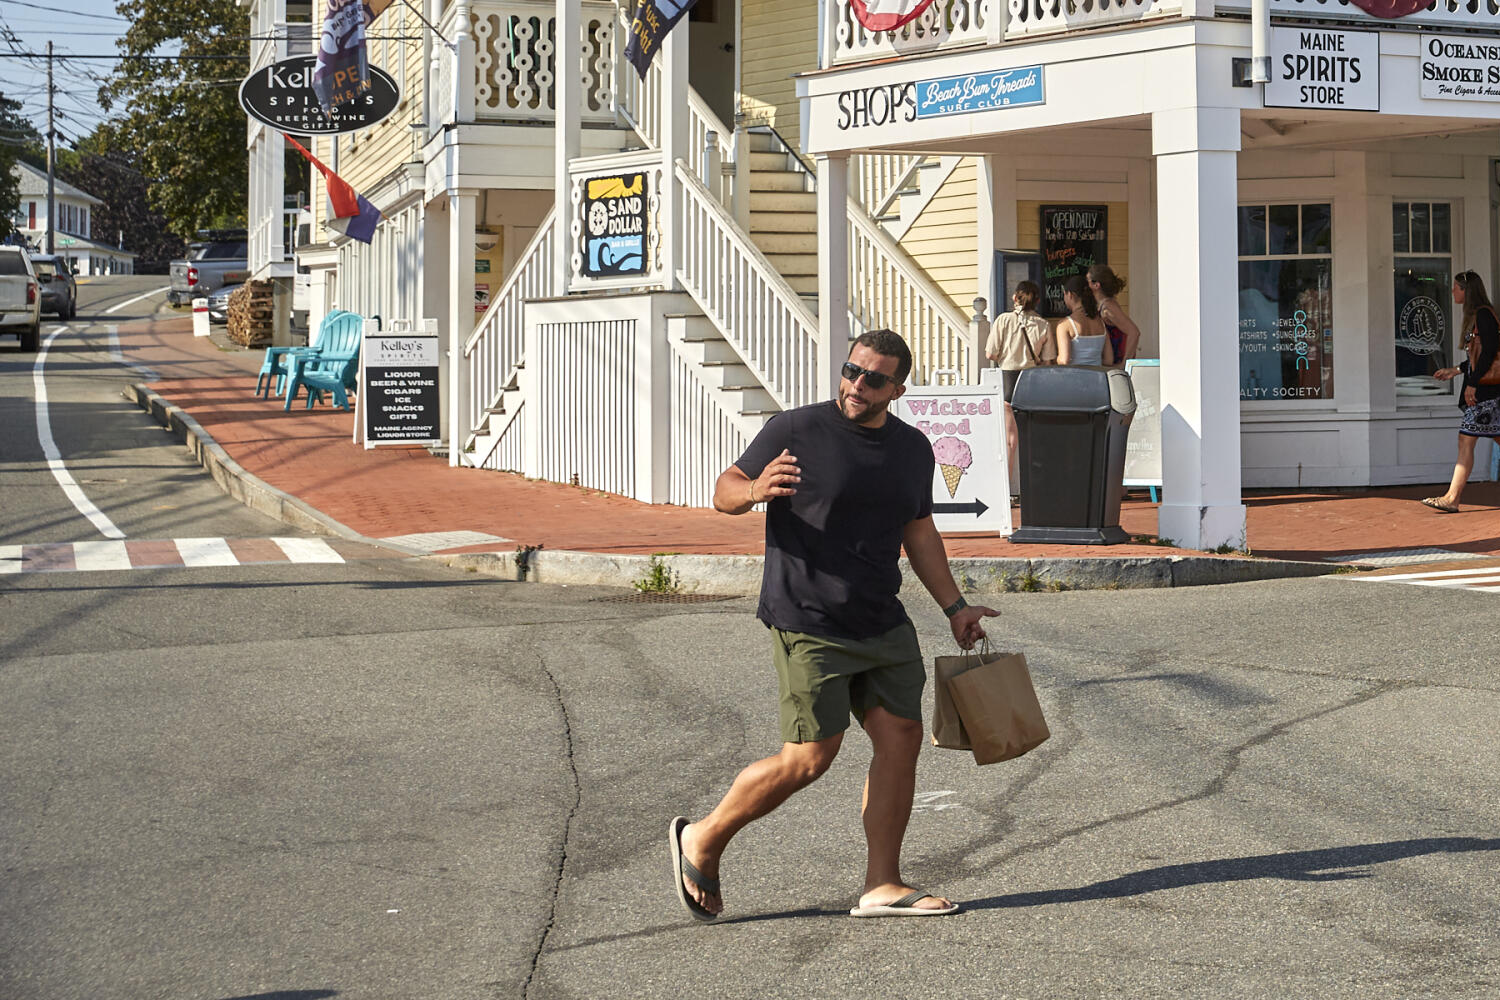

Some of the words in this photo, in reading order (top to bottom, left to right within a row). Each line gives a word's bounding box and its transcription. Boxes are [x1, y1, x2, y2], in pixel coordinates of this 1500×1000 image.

[1301, 32, 1345, 52] MAINE
[1283, 54, 1361, 83] SPIRITS
[1422, 62, 1483, 82] SMOKE
[922, 82, 962, 109] Beach
[959, 76, 991, 104] Bum
[991, 71, 1037, 100] Threads
[1301, 86, 1344, 104] STORE
[1439, 85, 1453, 95] Fine
[1455, 85, 1476, 96] Cigars
[1478, 86, 1483, 95] &
[838, 82, 916, 130] SHOPS
[940, 103, 971, 113] SURF
[979, 98, 1011, 109] CLUB
[609, 198, 642, 217] SAND
[609, 216, 642, 235] DOLLAR
[1053, 212, 1075, 230] OPEN
[1076, 212, 1098, 229] DAILY
[381, 341, 424, 354] Kelley's
[1240, 388, 1268, 397] ALTY
[1273, 387, 1321, 396] SOCIETY
[906, 398, 992, 415] Wicked
[916, 419, 972, 435] Good
